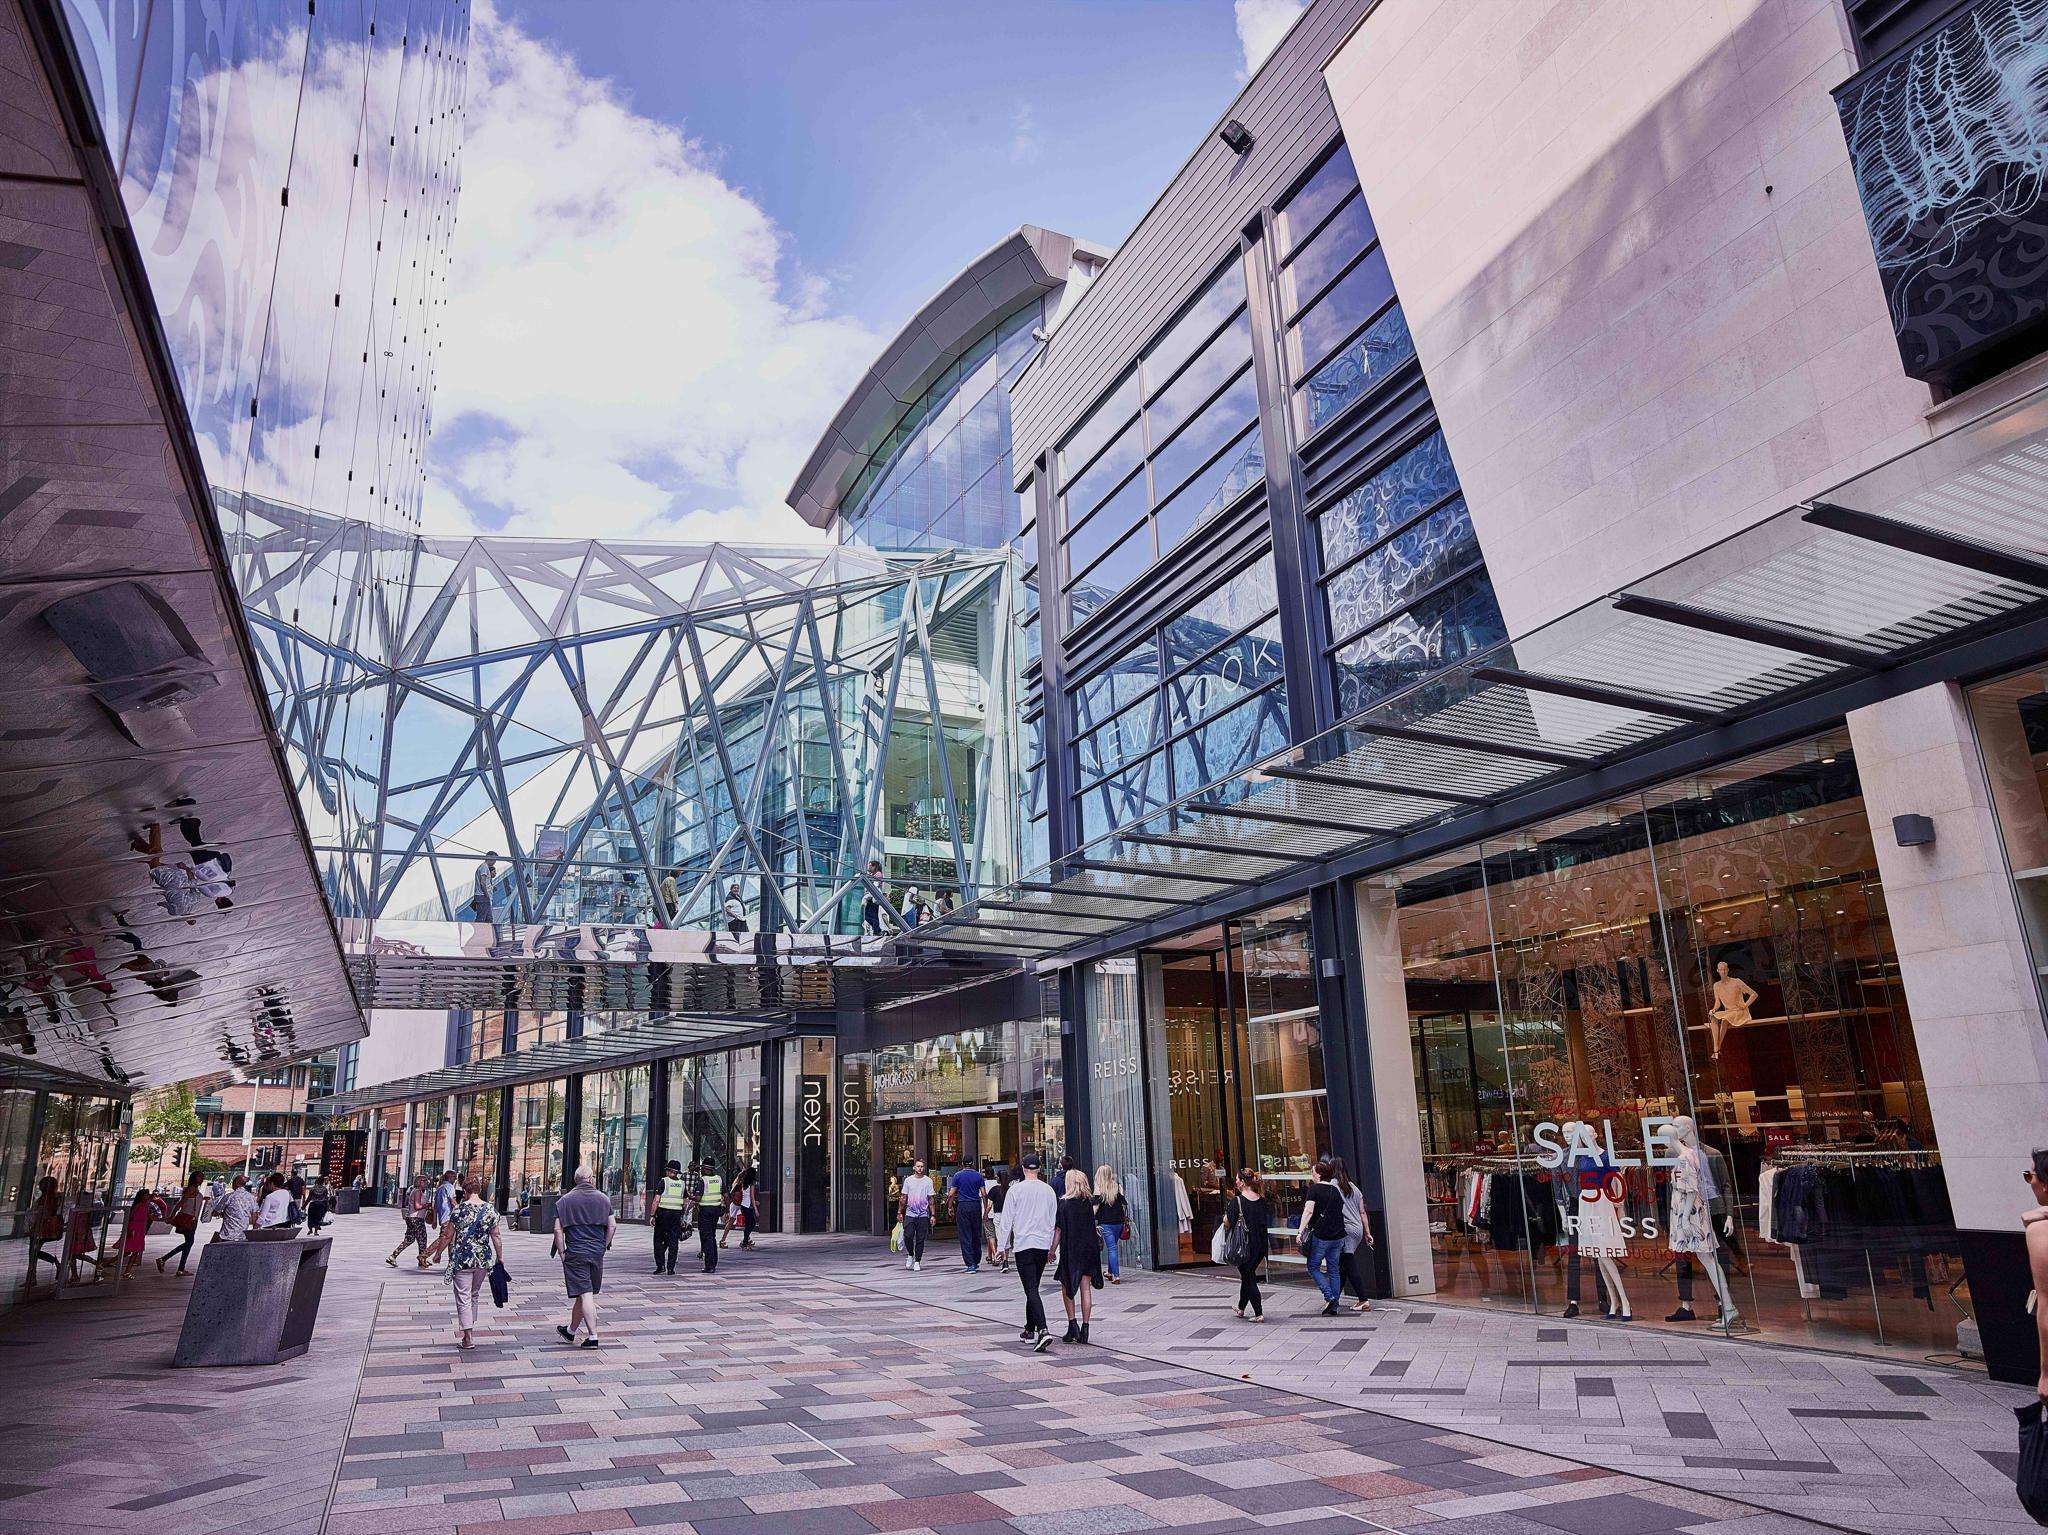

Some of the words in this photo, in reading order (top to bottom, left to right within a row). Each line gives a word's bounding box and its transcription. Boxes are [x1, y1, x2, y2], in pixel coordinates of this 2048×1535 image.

[1084, 707, 1152, 776] NEW
[1169, 632, 1277, 728] LOOK
[1094, 1057, 1137, 1079] REISS
[804, 1081, 822, 1146] next
[1533, 1116, 1682, 1169] SALE
[1169, 1158, 1209, 1169] REISS
[1567, 1215, 1659, 1240] REISS
